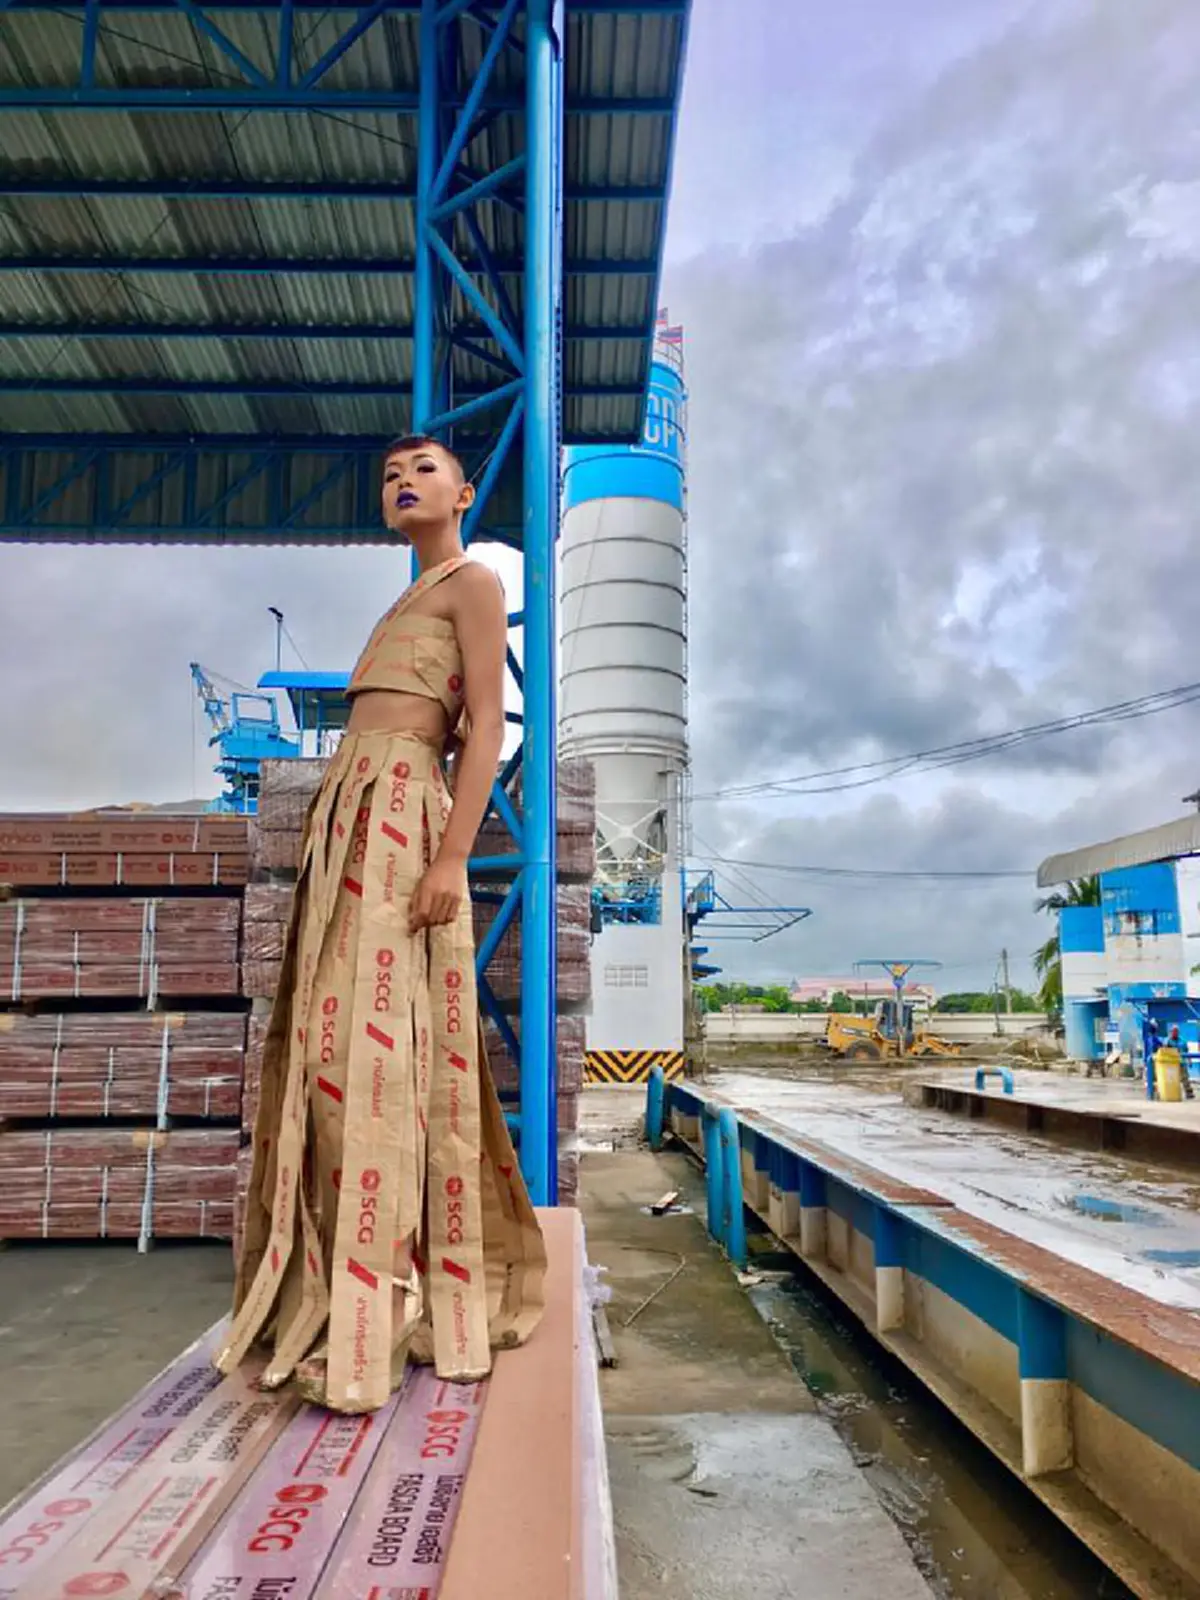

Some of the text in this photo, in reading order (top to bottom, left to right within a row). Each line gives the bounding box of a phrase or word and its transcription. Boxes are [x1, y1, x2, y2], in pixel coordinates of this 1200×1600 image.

[389, 780, 406, 812] SCG
[375, 971, 391, 1012] SCG
[446, 993, 461, 1034] SCG
[320, 1020, 335, 1063] SCG
[357, 1197, 377, 1244] SCG
[447, 1201, 463, 1245] SCG
[420, 1424, 460, 1459] SCG
[248, 1506, 310, 1553] SCG
[367, 1474, 423, 1566] FASCIA BOARD
[0, 1520, 65, 1564] SCG
